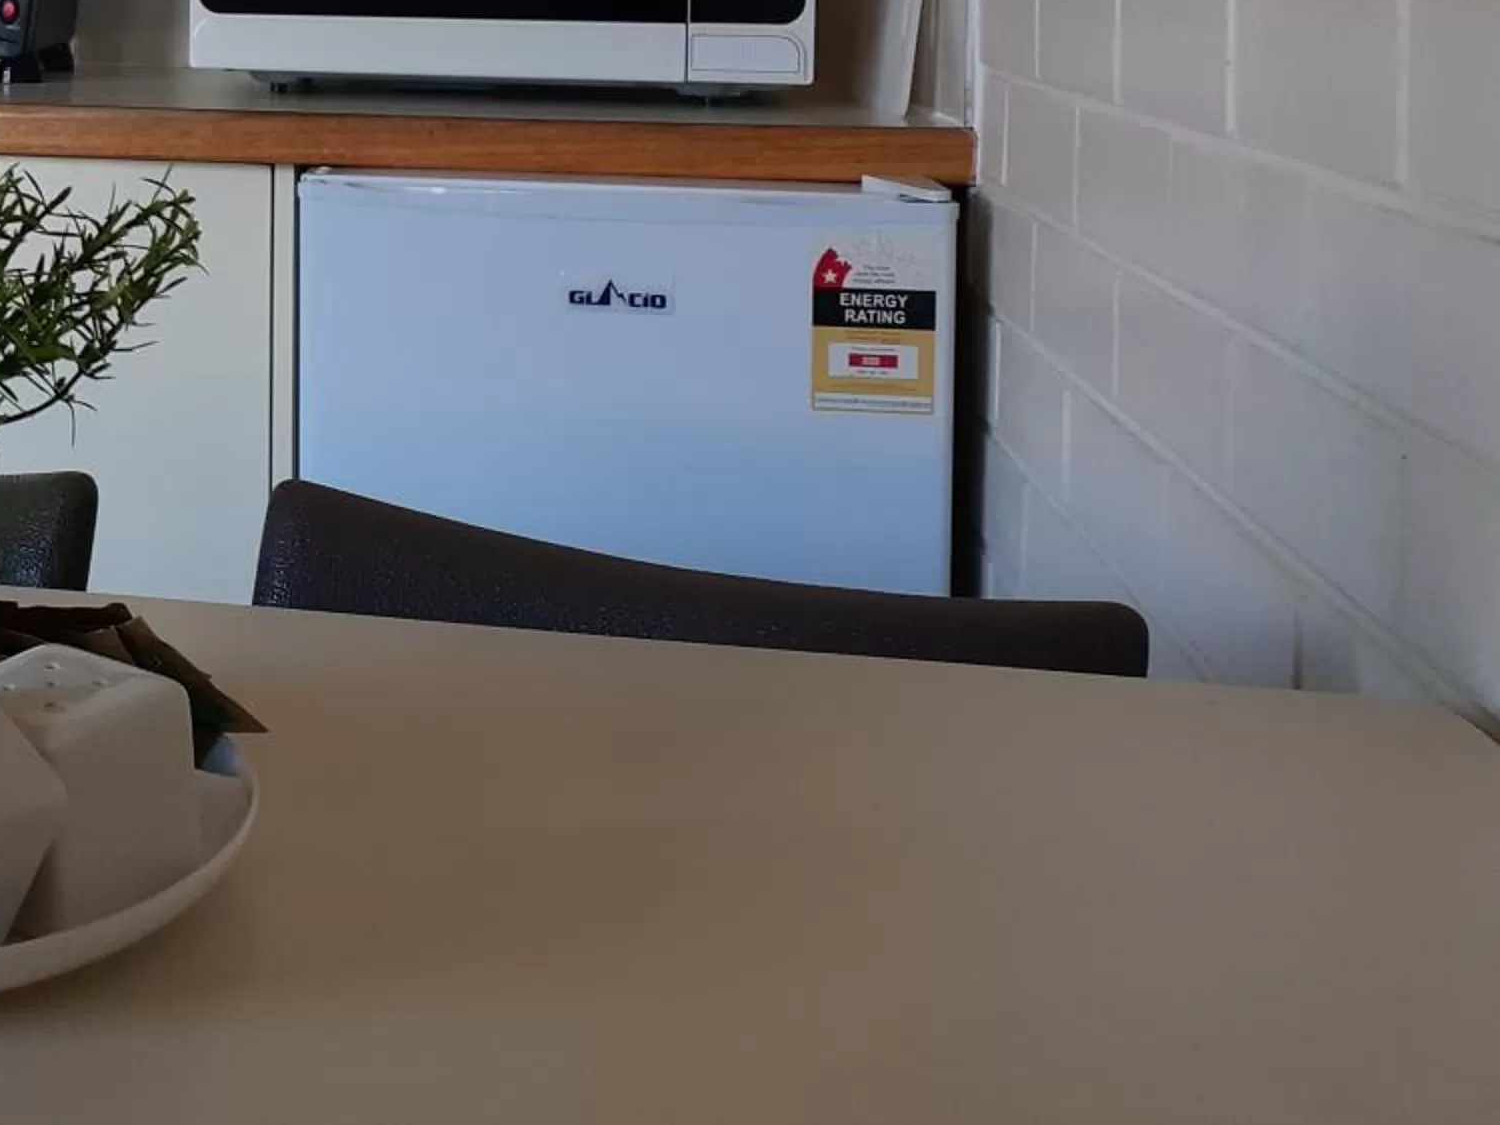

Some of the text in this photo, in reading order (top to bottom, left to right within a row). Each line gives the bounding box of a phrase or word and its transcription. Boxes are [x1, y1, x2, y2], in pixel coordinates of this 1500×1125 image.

[568, 279, 667, 309] GLACIO
[839, 292, 908, 308] ENERGY
[844, 308, 906, 324] RATING
